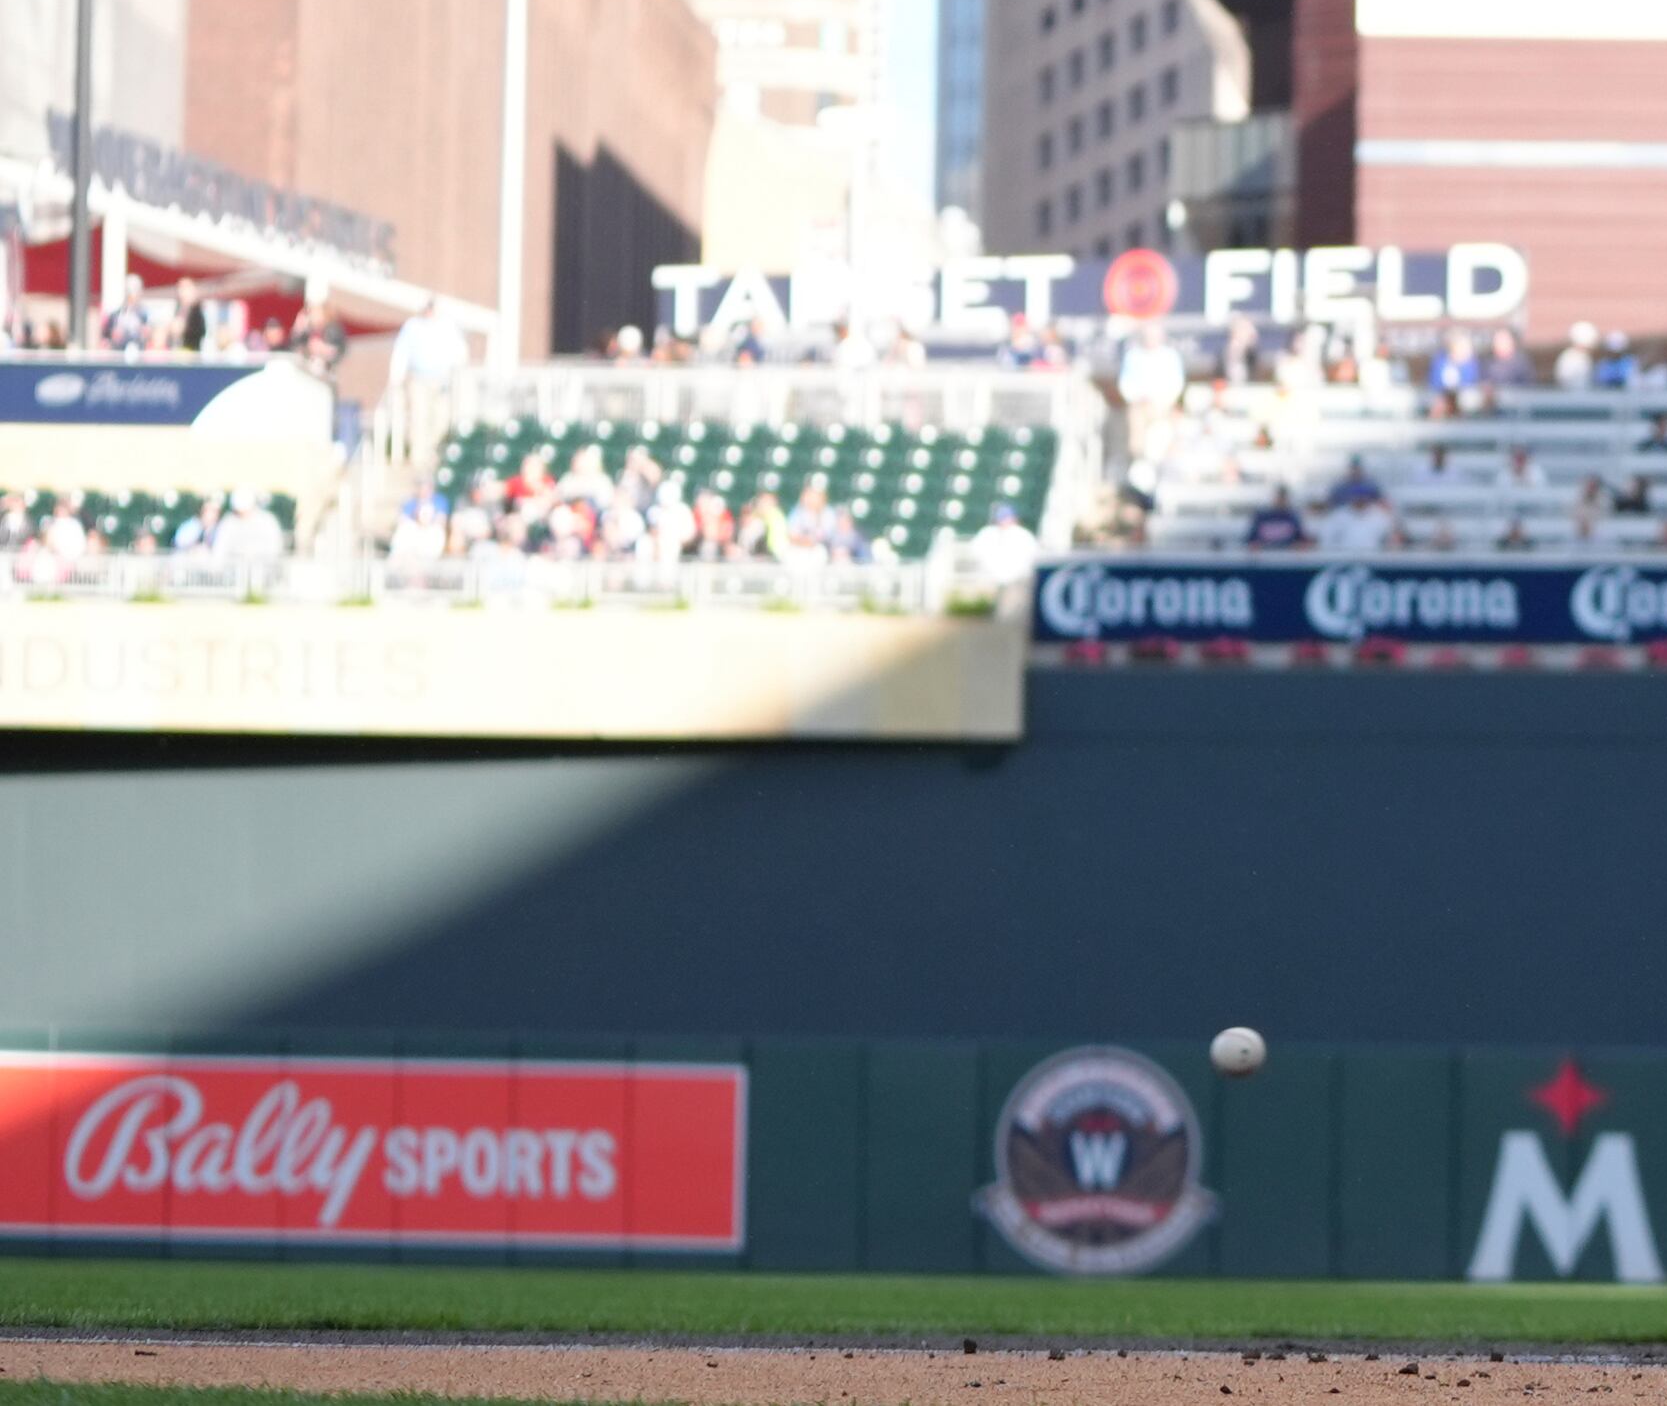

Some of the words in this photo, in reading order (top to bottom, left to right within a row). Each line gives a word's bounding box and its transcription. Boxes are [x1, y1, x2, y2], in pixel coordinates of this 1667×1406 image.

[1204, 244, 1529, 325] FIELD
[1040, 561, 1252, 637] Corona
[1306, 561, 1519, 641] Corona
[0, 634, 431, 701] DUSTRIES
[64, 1074, 376, 1230] Bally
[383, 1126, 619, 1201] SPORTS
[1068, 1129, 1129, 1192] W
[1466, 1129, 1665, 1283] M
